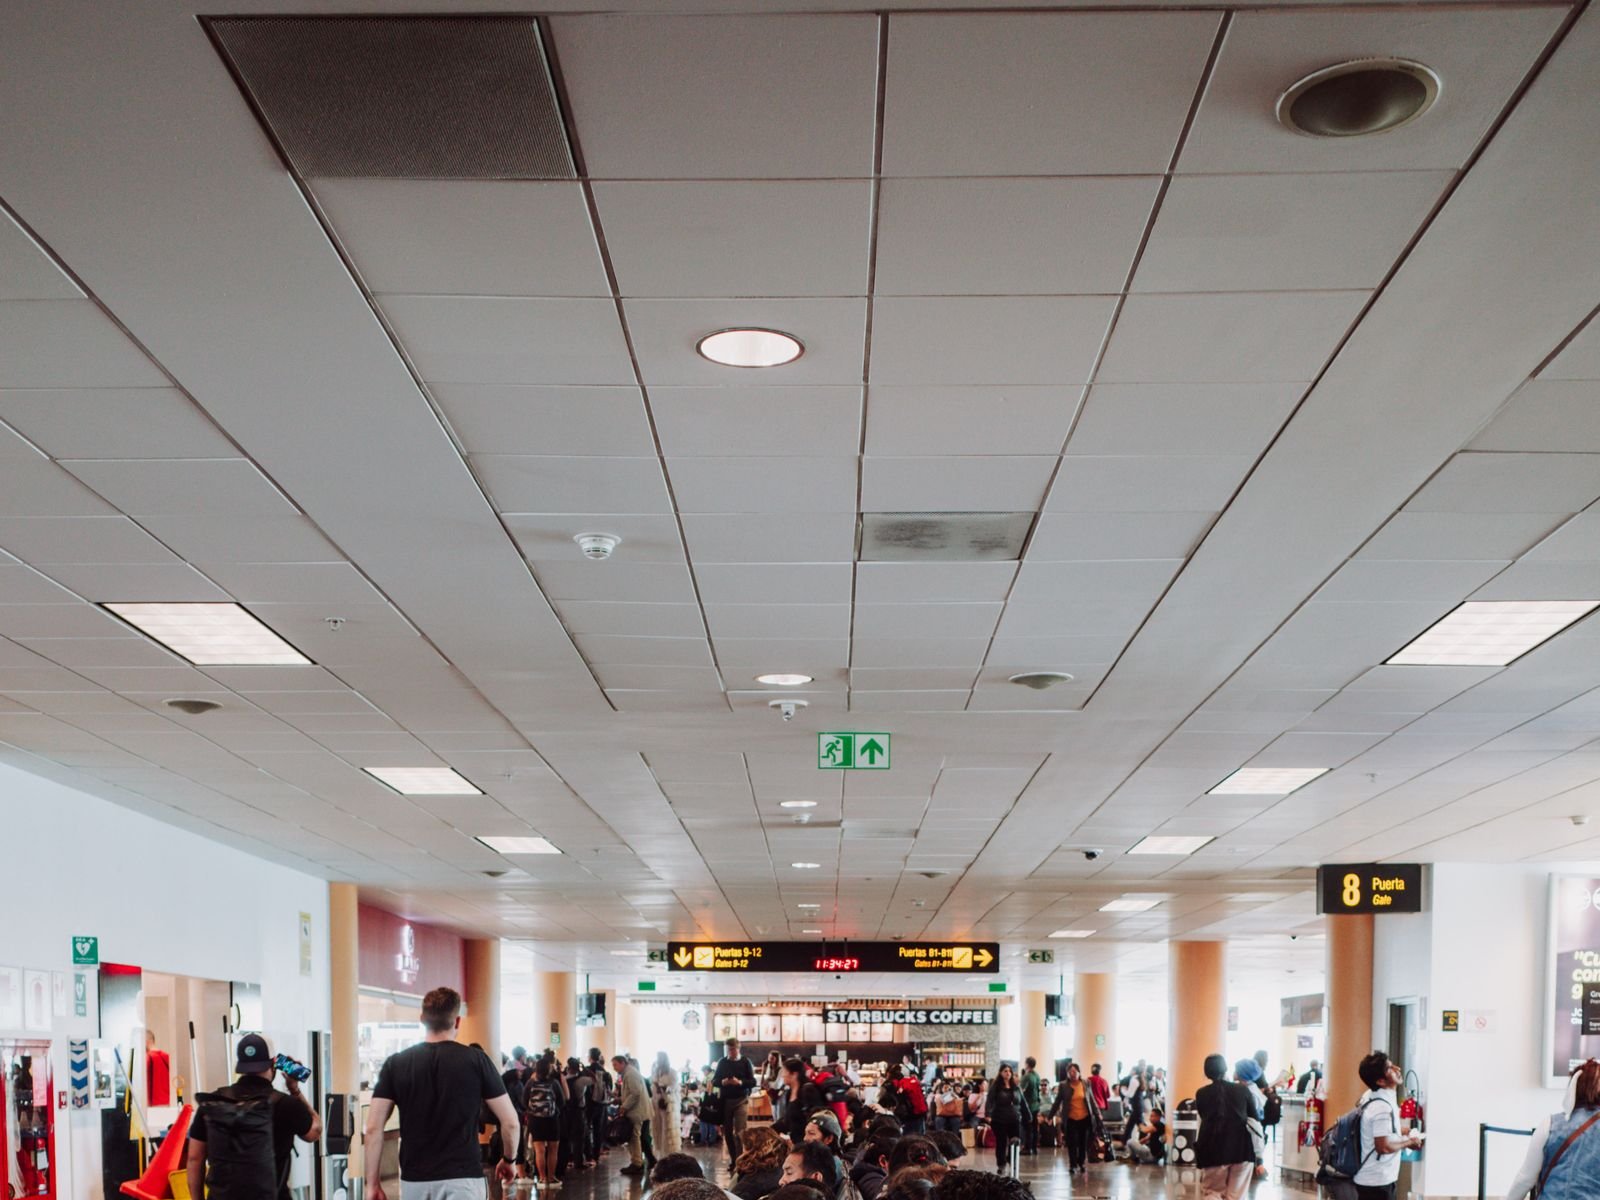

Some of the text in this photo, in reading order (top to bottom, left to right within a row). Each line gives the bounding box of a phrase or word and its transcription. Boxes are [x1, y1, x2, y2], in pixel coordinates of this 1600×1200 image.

[1343, 873, 1360, 906] 8
[1371, 877, 1405, 891] Puerta
[1372, 894, 1392, 906] Gate
[714, 947, 762, 958] Puertas 9-12
[899, 947, 927, 958] Puertas
[714, 959, 749, 968] Gates 9-12
[816, 959, 858, 970] 11:34:27
[914, 960, 931, 968] Gates
[827, 1010, 993, 1023] STARBUCKS COFFEE
